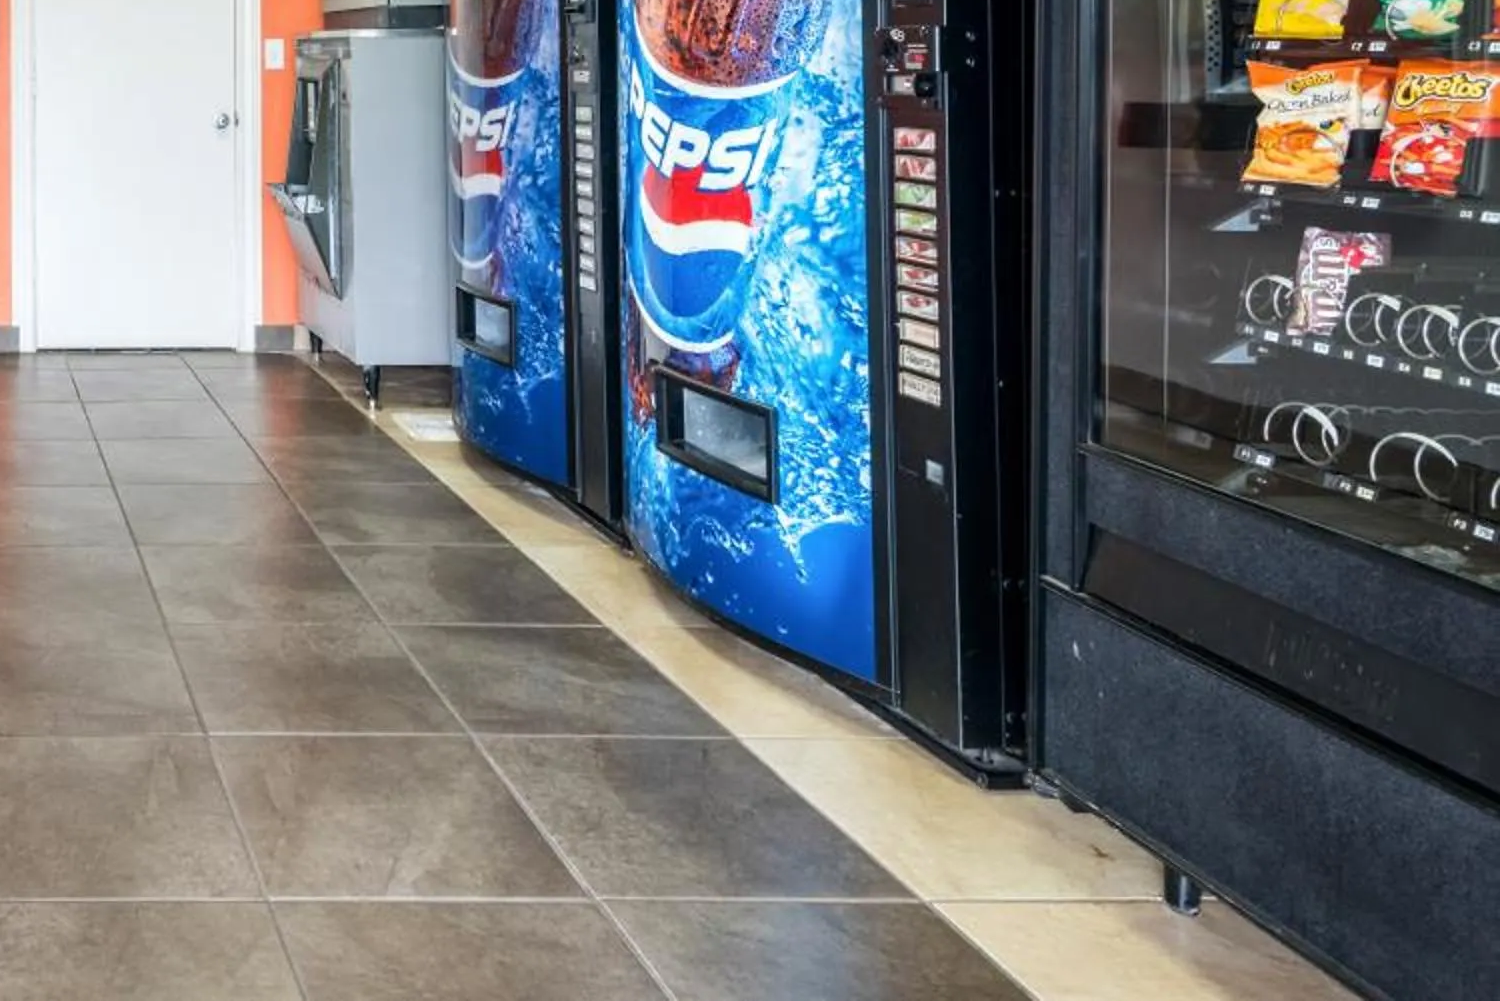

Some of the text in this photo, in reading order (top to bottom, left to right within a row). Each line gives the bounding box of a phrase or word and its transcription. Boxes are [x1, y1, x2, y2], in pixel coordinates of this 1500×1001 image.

[1396, 74, 1488, 106] Cheetos
[450, 91, 516, 152] EPSI
[630, 59, 779, 191] PEPSI
